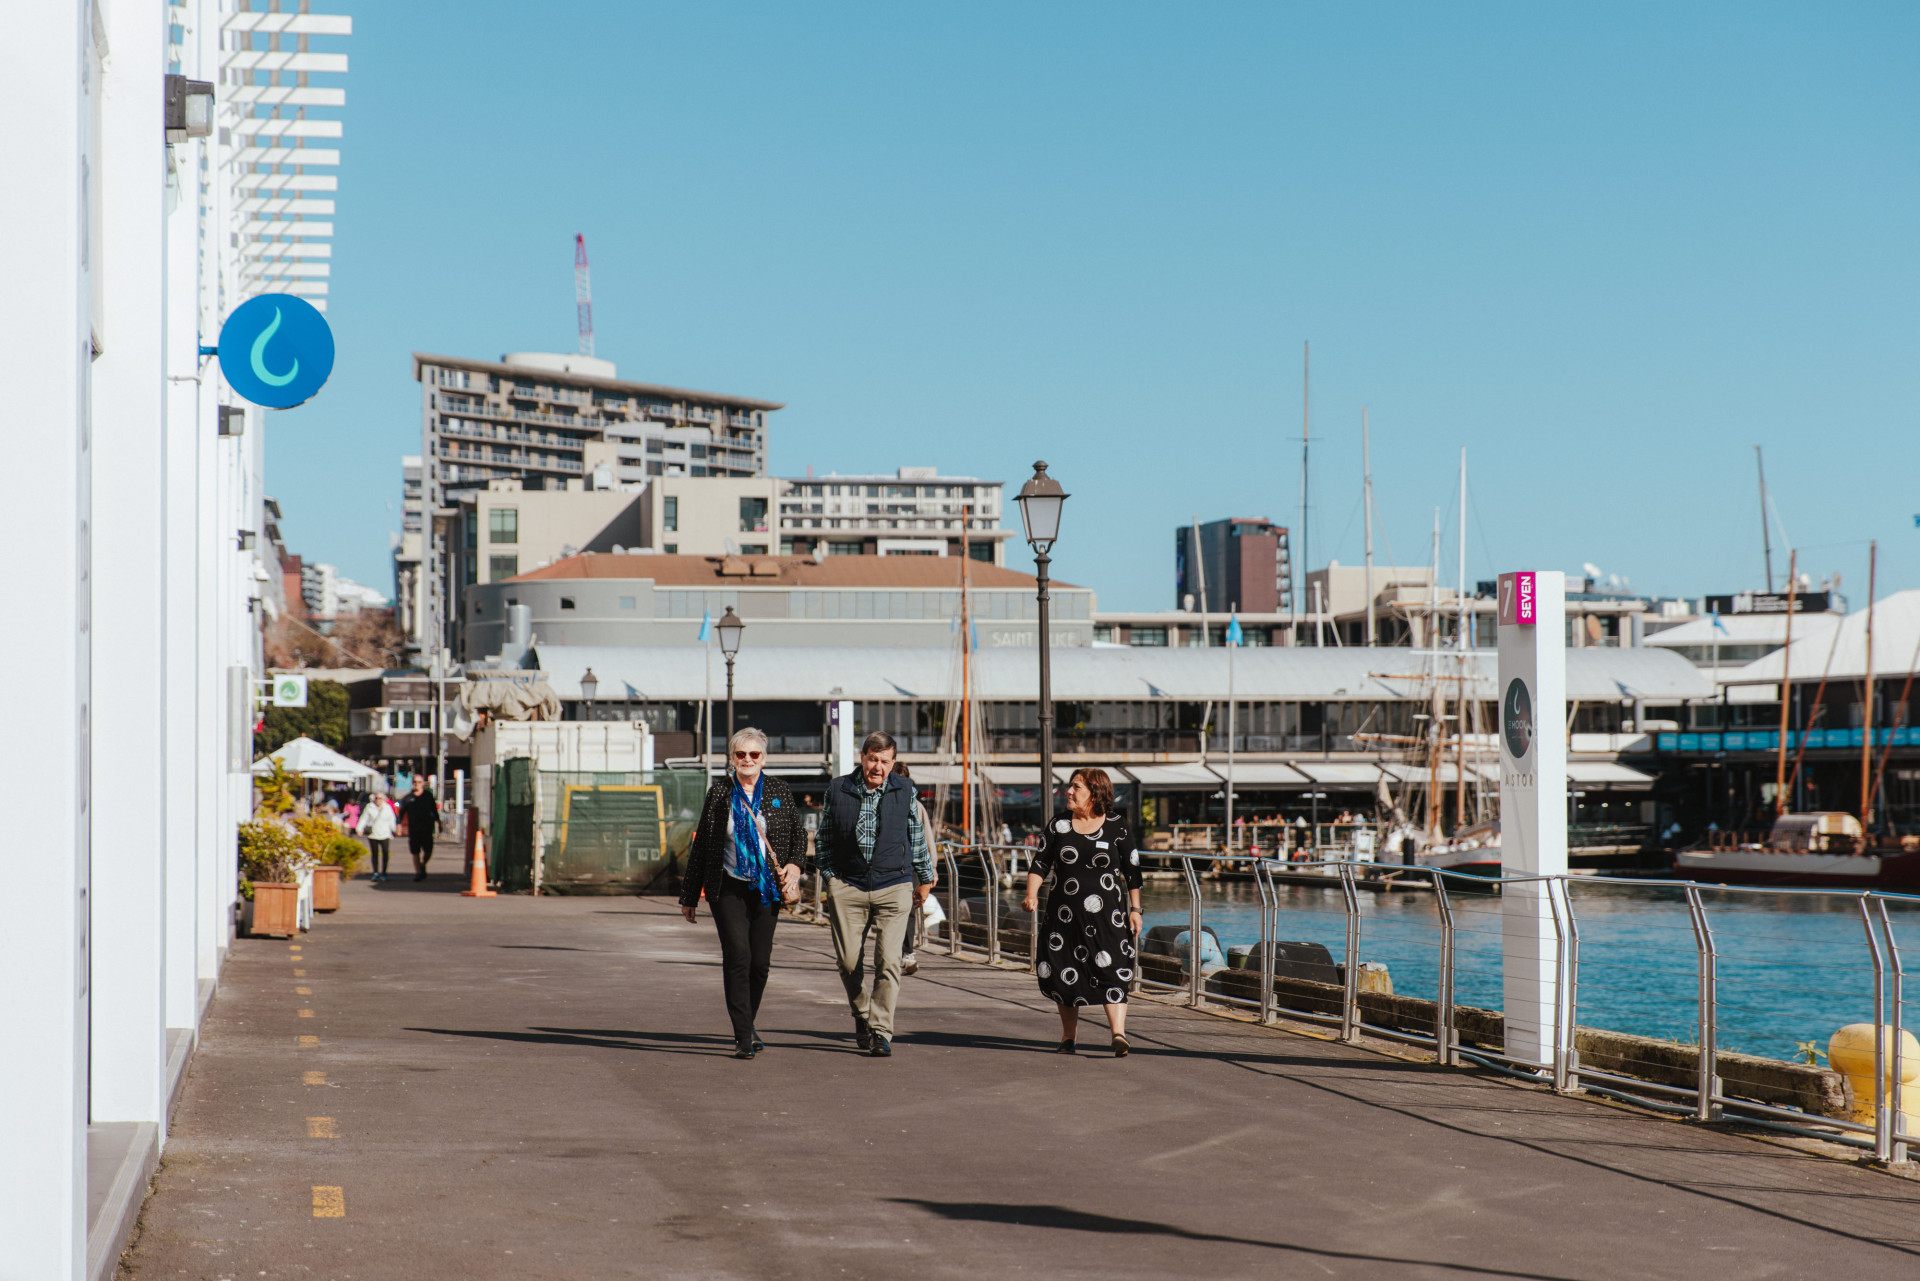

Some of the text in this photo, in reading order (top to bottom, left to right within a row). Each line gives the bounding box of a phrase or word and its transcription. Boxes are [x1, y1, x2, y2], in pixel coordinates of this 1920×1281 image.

[1503, 580, 1512, 617] 7
[1520, 576, 1532, 619] SEVEN
[992, 631, 1076, 647] SAINT LICE
[1505, 773, 1534, 787] ASTOR
